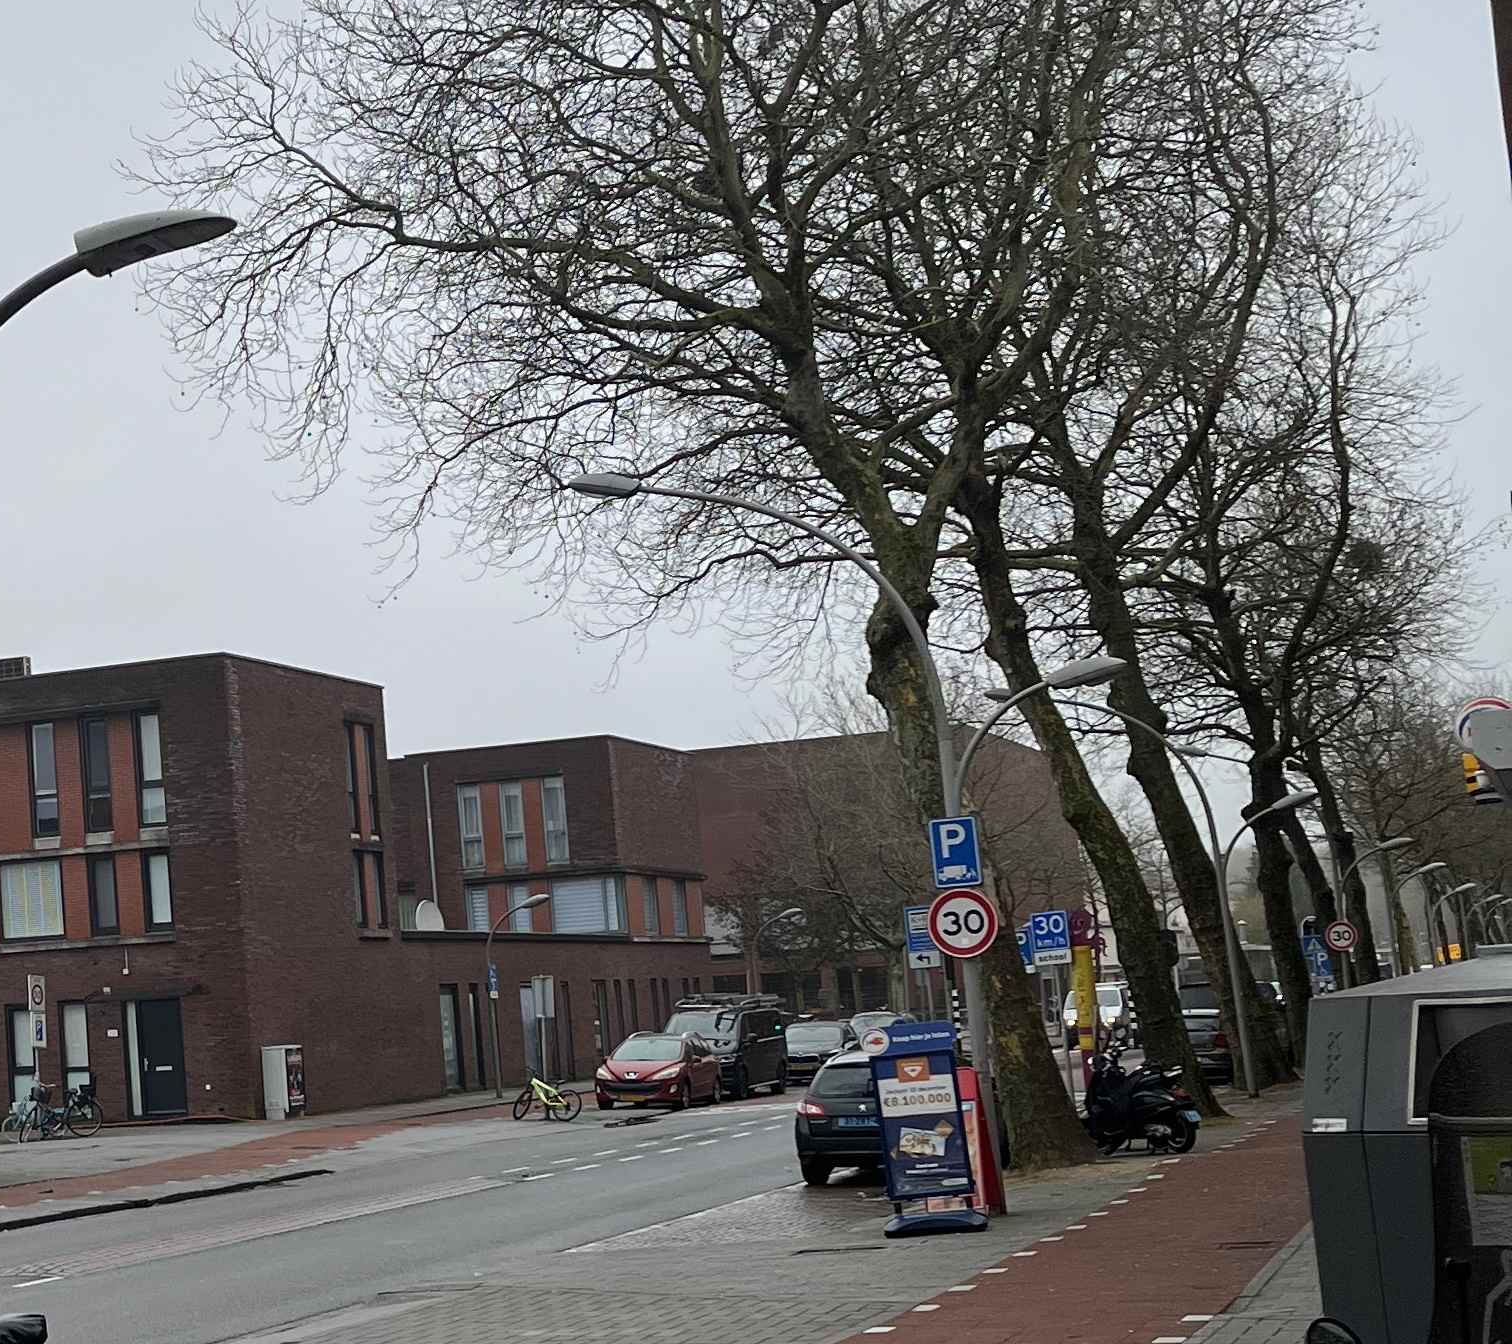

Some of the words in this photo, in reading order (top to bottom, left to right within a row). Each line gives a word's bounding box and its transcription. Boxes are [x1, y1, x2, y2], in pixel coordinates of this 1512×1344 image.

[939, 824, 966, 859] P
[942, 909, 985, 937] 30
[1034, 915, 1064, 935] 30
[1036, 936, 1066, 948] km/h
[1333, 930, 1351, 942] 30
[1038, 952, 1067, 962] school
[1317, 952, 1329, 966] P
